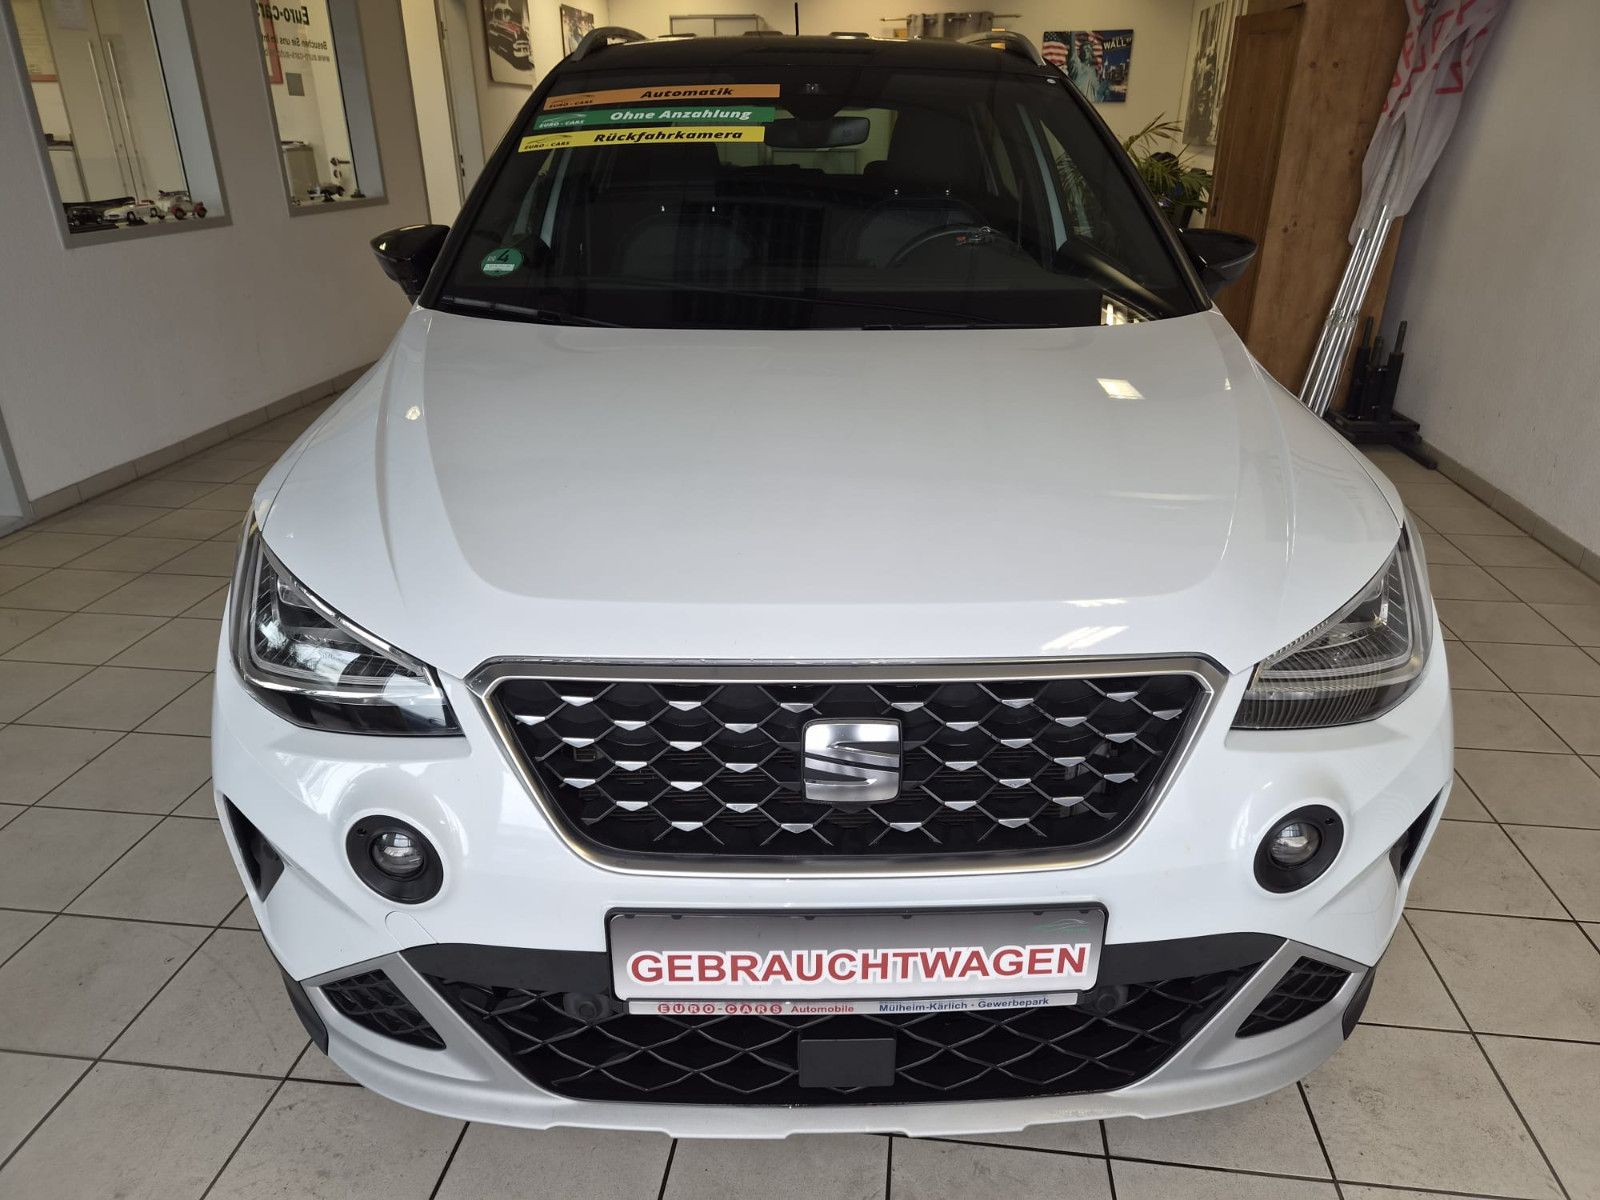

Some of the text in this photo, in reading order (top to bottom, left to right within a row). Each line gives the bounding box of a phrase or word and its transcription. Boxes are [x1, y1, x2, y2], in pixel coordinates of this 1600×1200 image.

[1103, 39, 1127, 50] WALL
[640, 87, 734, 99] Automatik
[610, 109, 753, 121] Ohne Anzahlung
[539, 121, 560, 129] EURO
[593, 131, 743, 143] Rückfahrkamera
[496, 249, 510, 263] 4
[629, 945, 1089, 984] GEBRAUCHTWAGEN
[790, 1004, 855, 1014] Automobile
[879, 1001, 968, 1012] Mülheim-Kärlich
[978, 997, 1050, 1009] Gewerbepark
